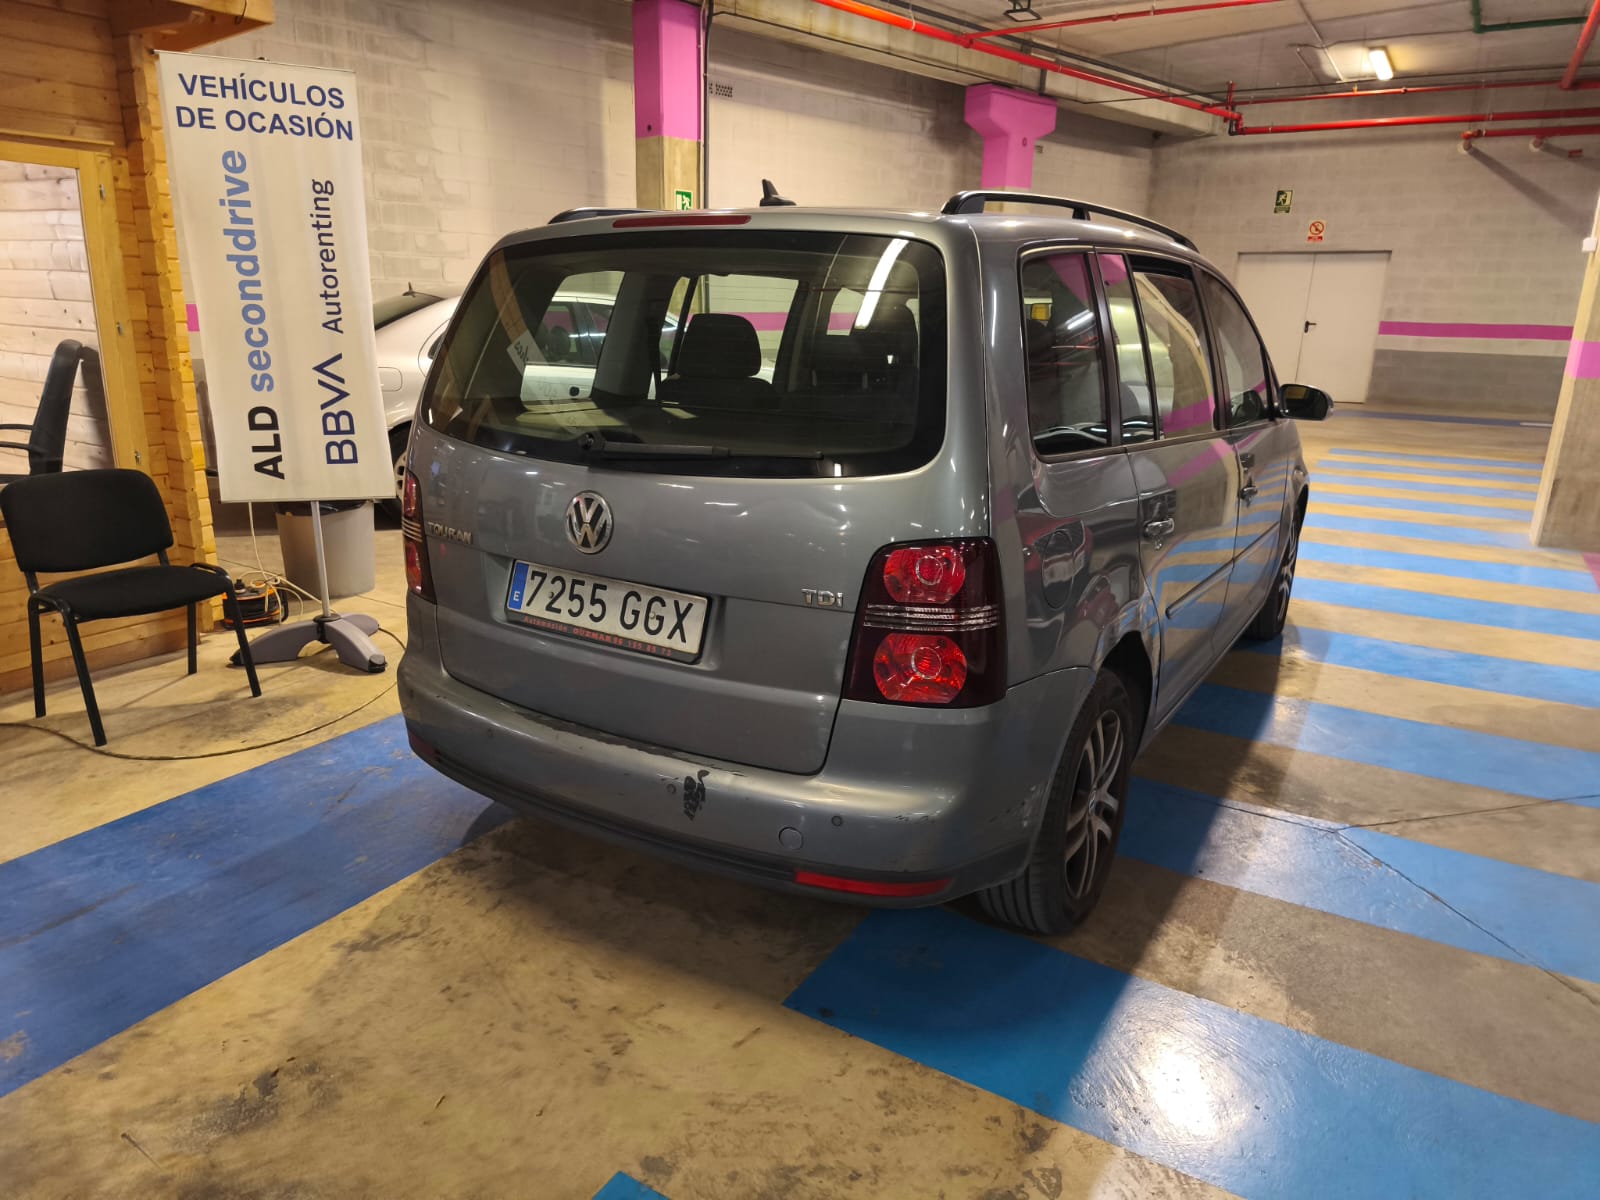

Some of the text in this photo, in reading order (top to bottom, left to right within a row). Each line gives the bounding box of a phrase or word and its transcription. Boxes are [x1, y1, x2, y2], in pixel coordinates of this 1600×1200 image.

[179, 73, 345, 109] VEHÍCULOS
[176, 106, 354, 141] DE OCASIÓN
[219, 150, 286, 481] ALD seconddrive
[310, 178, 359, 466] BBVA Autorenting
[427, 521, 473, 545] TOURAN
[513, 591, 521, 602] E
[526, 570, 694, 644] 7255 GGX
